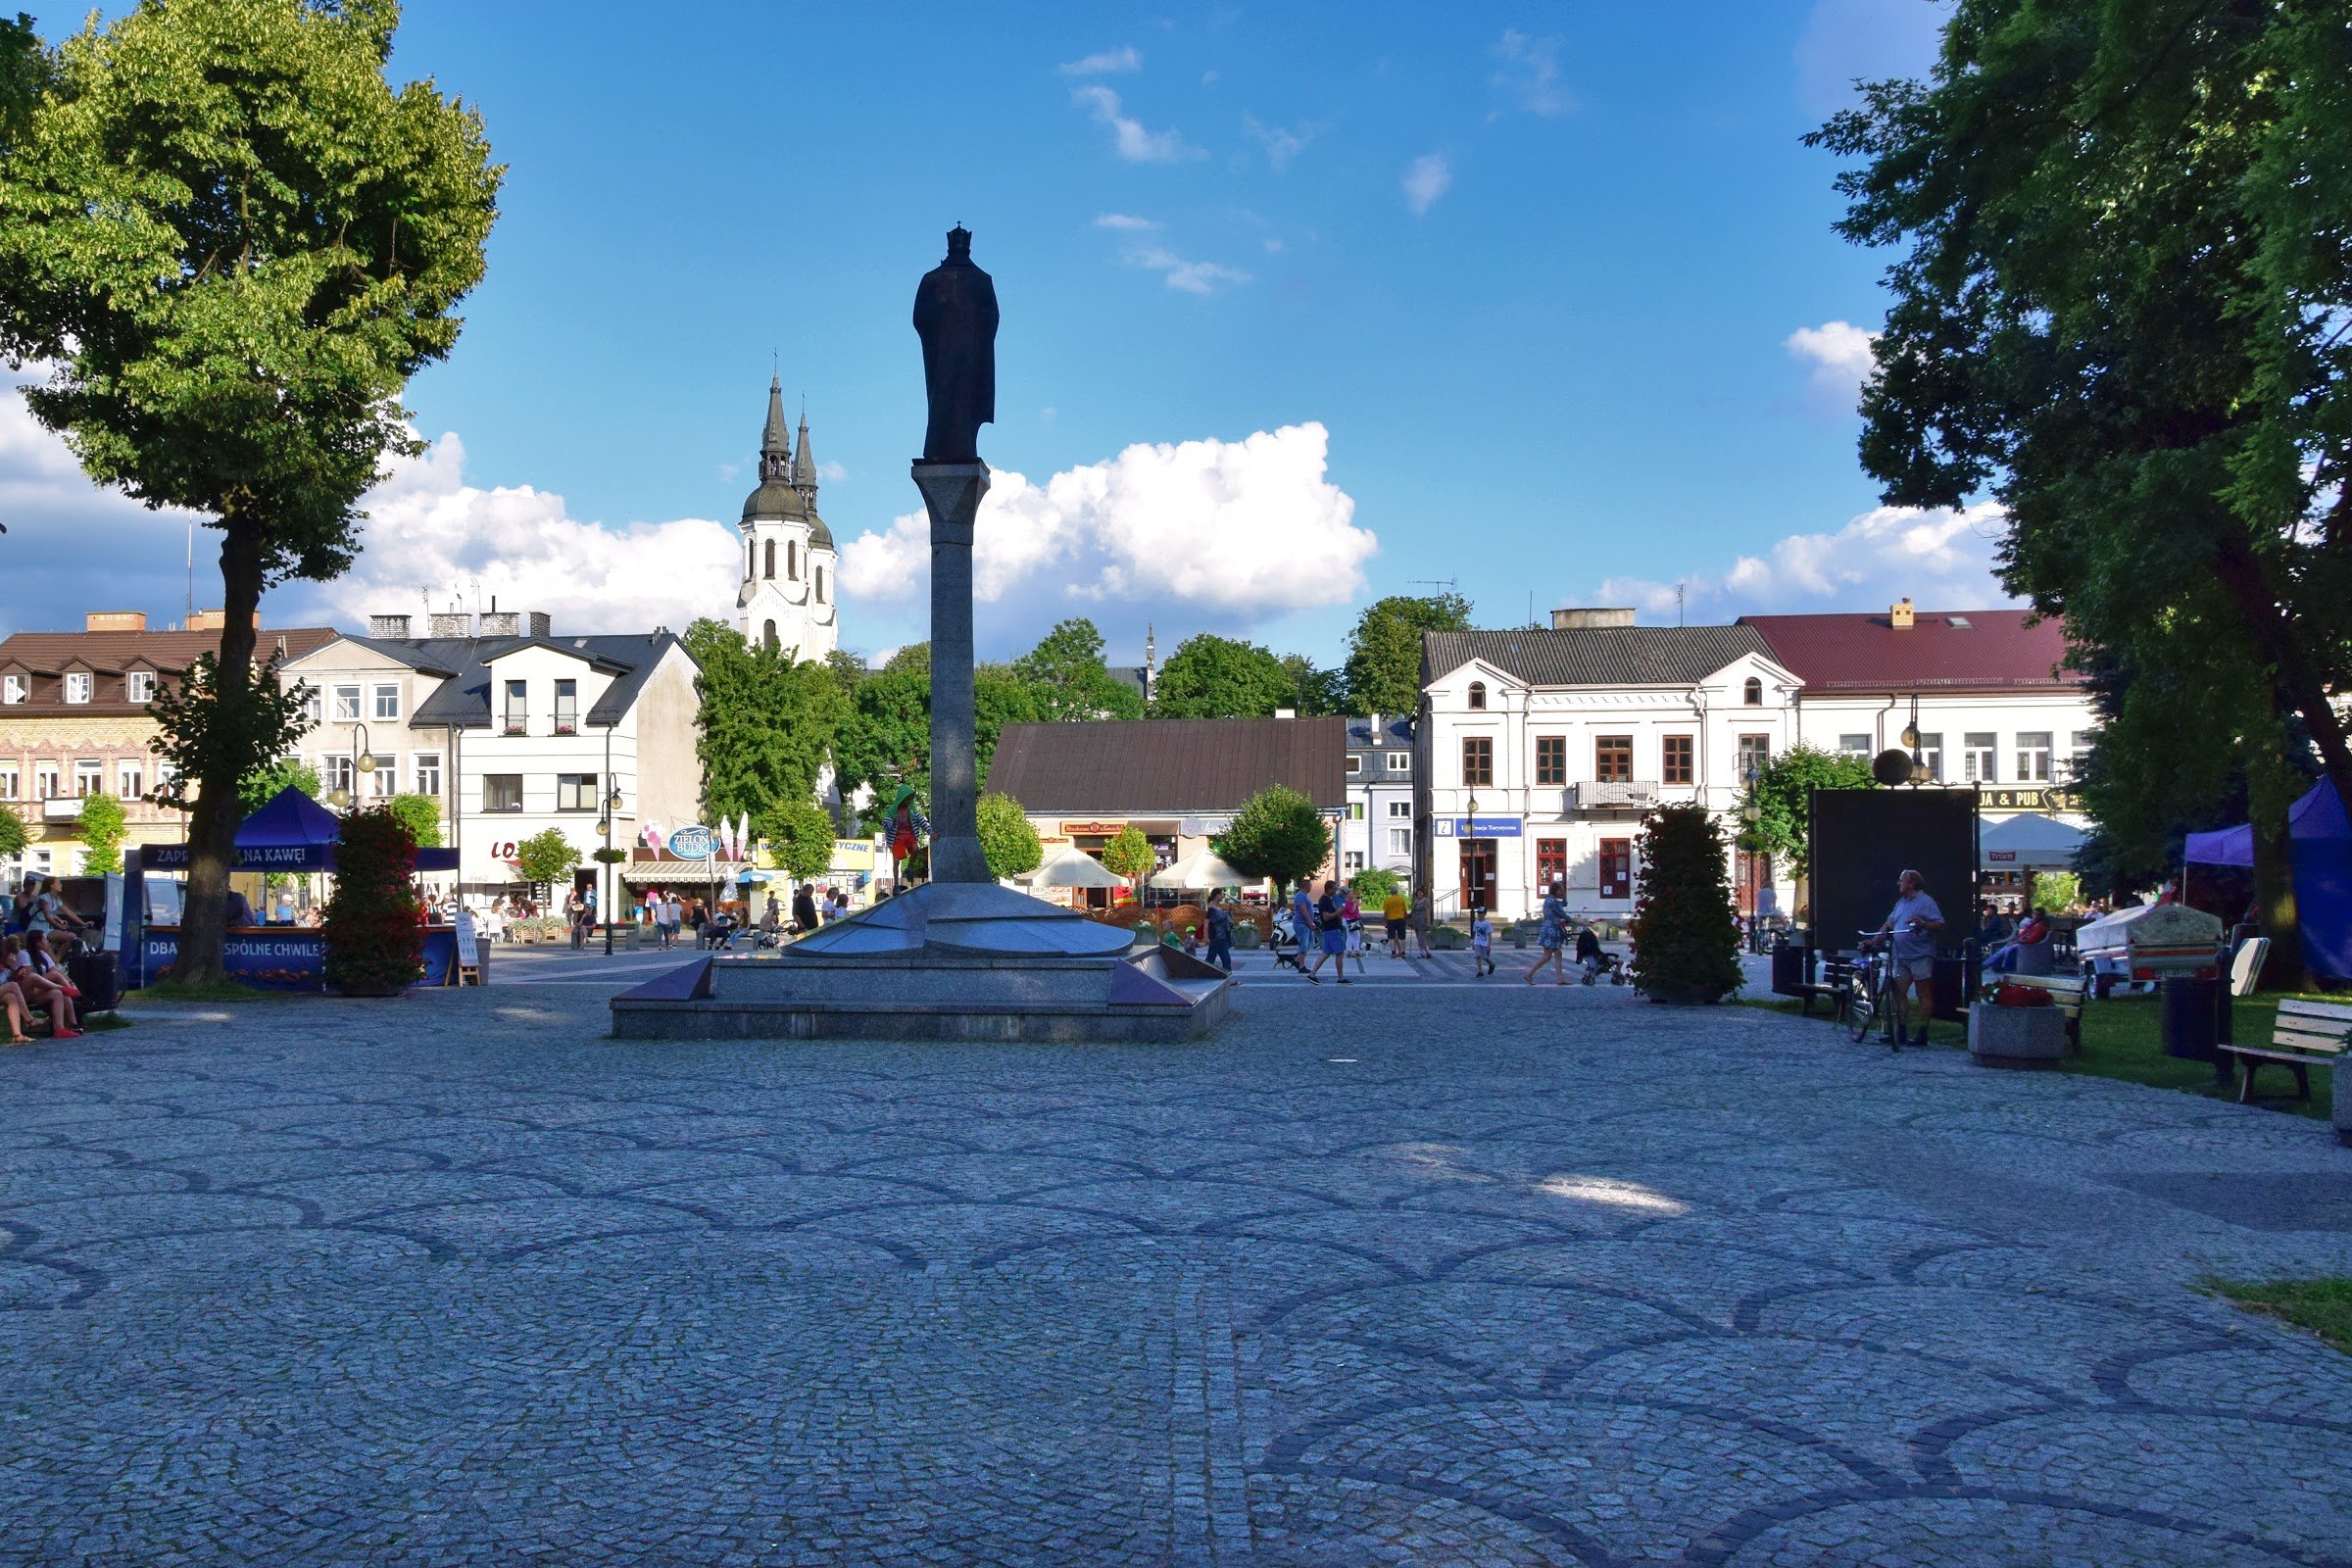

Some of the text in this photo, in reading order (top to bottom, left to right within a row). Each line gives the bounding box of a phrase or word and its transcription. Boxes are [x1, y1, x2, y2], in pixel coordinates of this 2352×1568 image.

[1999, 793, 2010, 806] &
[2016, 791, 2038, 806] PUB
[673, 834, 714, 844] ZIELONA
[677, 843, 711, 853] BUDKA
[266, 848, 306, 864] KAWĘ!
[1990, 853, 2014, 861] TYSKIE
[150, 939, 319, 957] DBA SPÓLNE CHWILE
